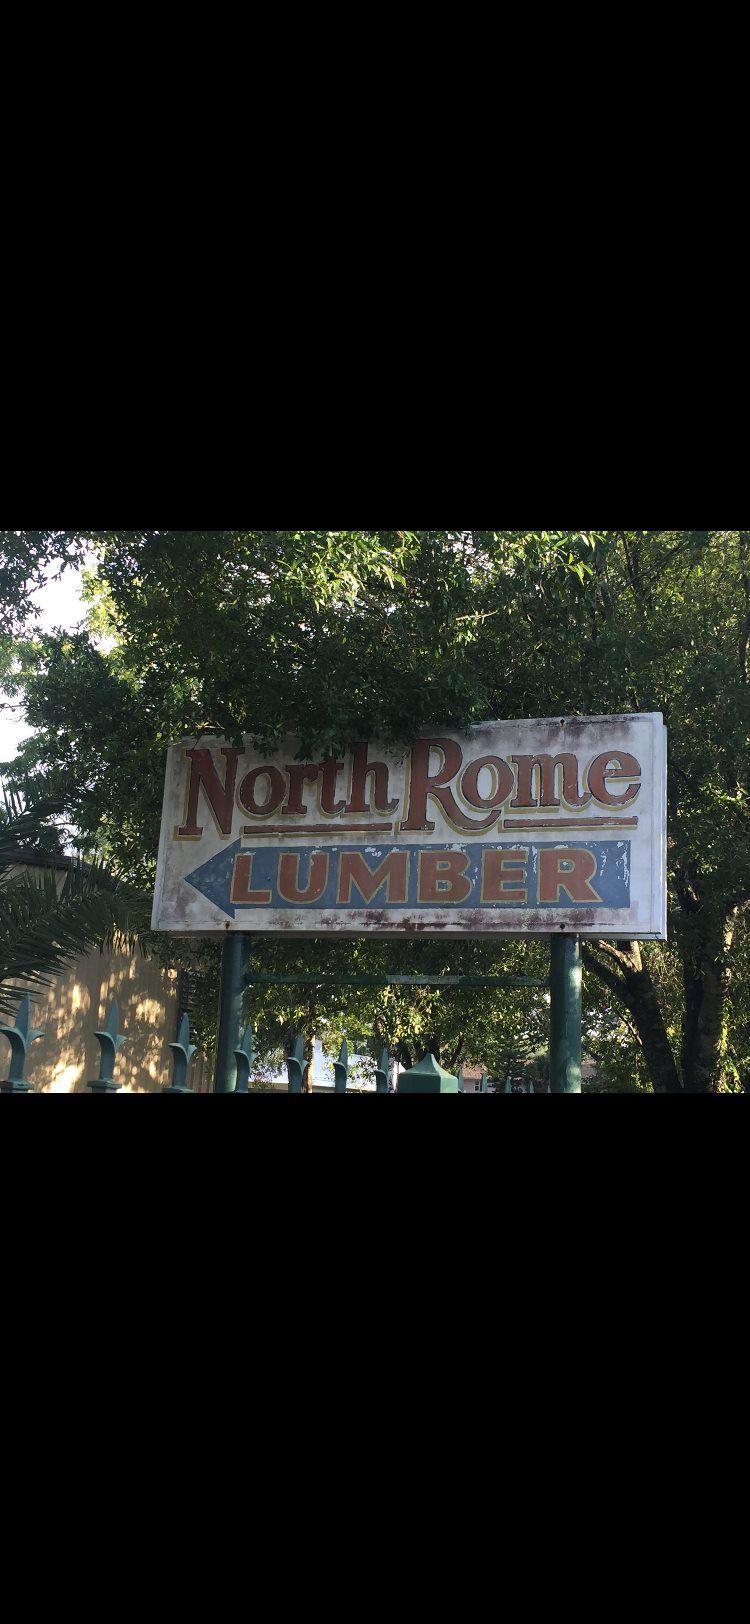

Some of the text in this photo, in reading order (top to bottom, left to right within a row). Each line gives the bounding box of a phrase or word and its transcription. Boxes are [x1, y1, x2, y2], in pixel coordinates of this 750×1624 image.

[176, 738, 641, 837] North Rome
[230, 849, 602, 904] LUMBER
